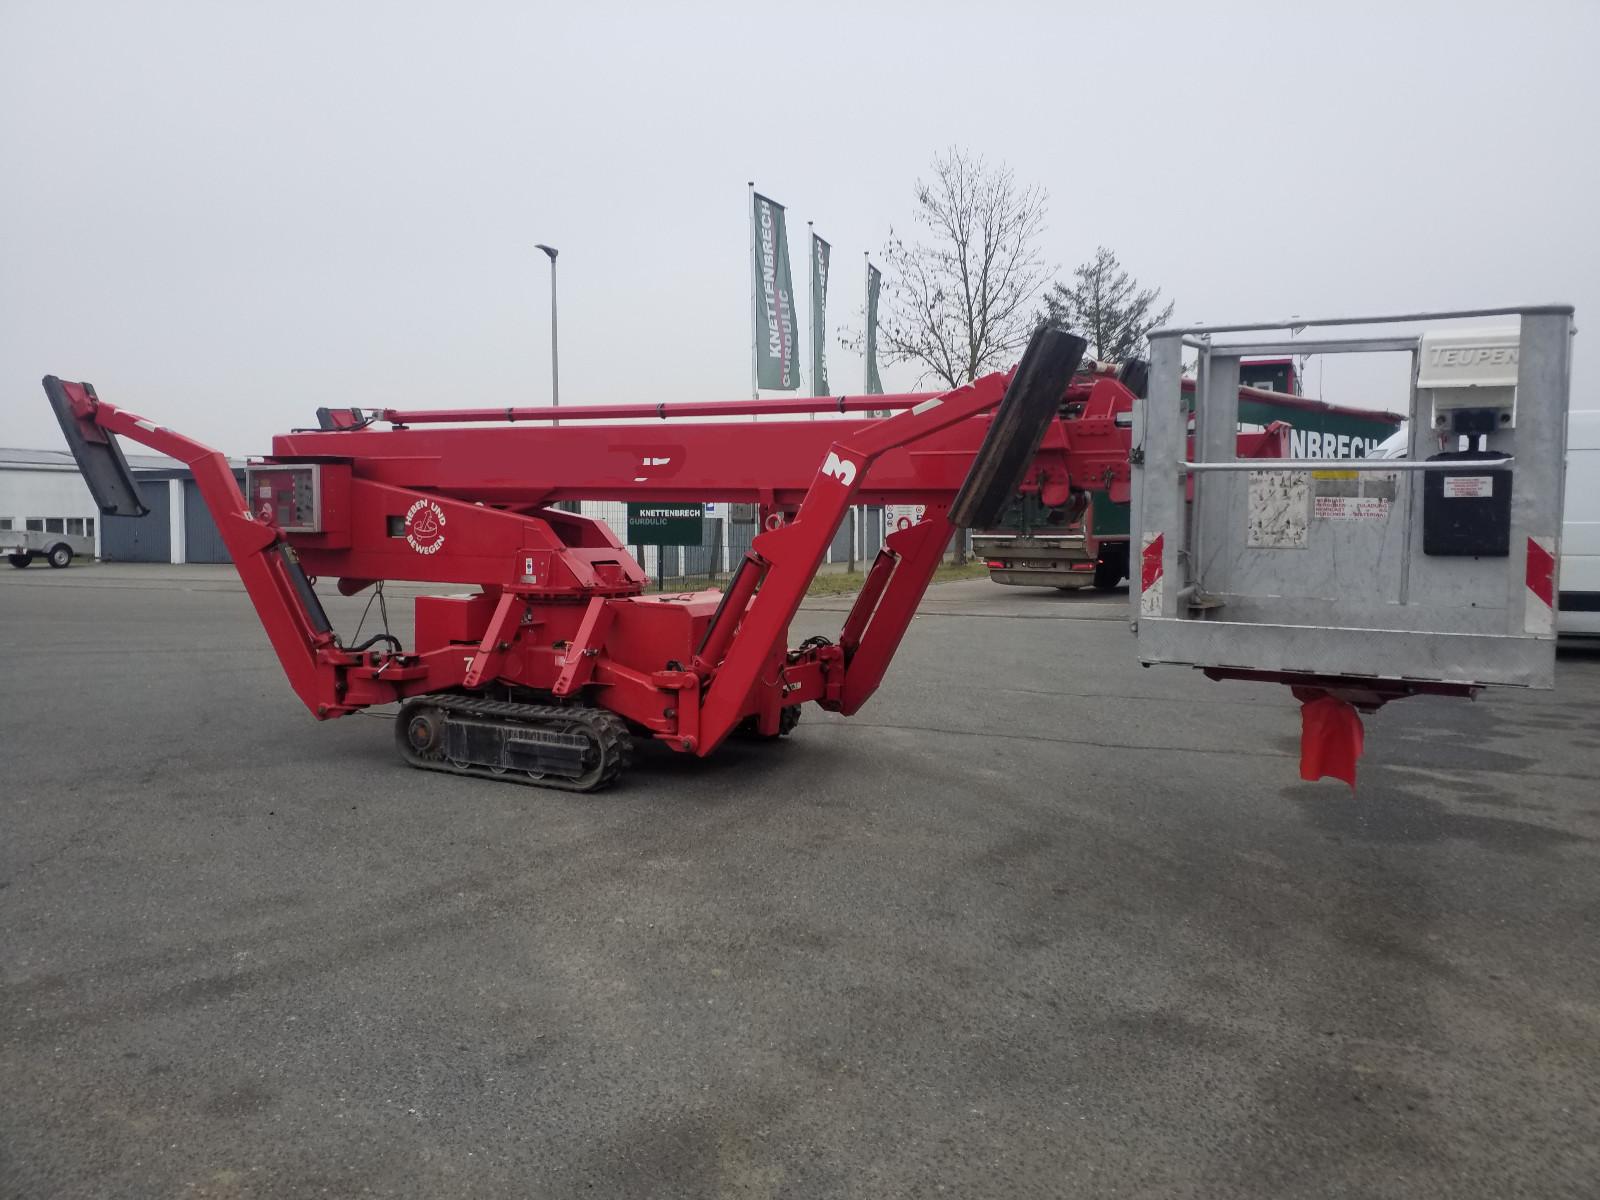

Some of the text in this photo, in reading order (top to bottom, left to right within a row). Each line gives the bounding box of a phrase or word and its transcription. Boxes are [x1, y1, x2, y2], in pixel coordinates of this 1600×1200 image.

[762, 200, 782, 358] KNETTENBRECH
[779, 290, 792, 387] GURDULIC
[1430, 346, 1519, 367] TEUPEN
[822, 451, 857, 487] 3
[405, 499, 446, 526] HEBEN UND
[629, 518, 668, 526] GURDULIC
[640, 509, 701, 517] KNETTENBRECH
[406, 534, 445, 555] BEWEGEN
[464, 656, 474, 672] 7
